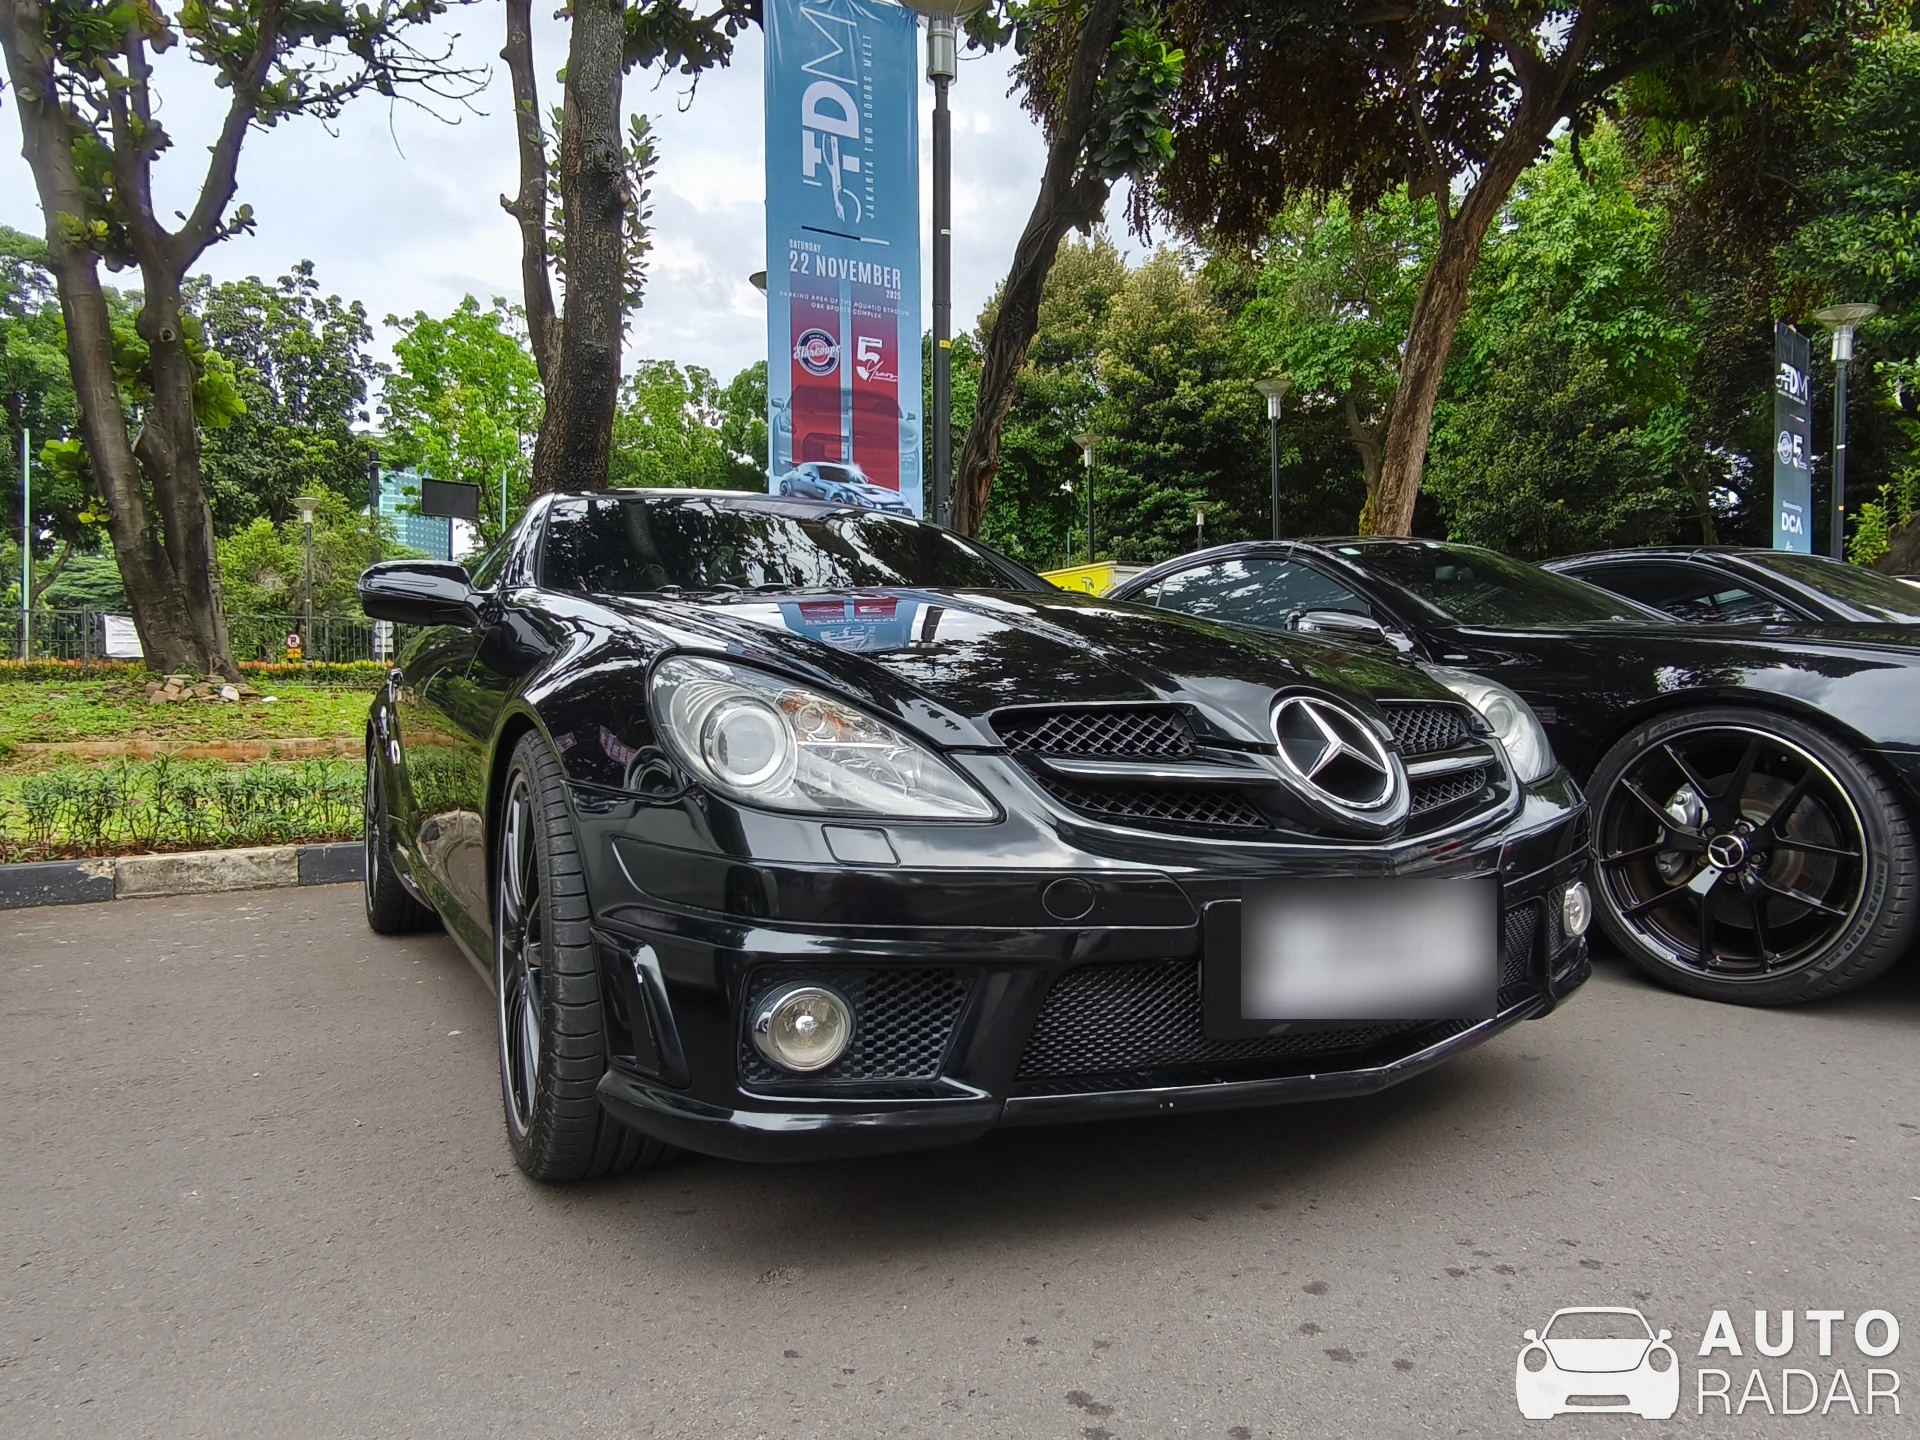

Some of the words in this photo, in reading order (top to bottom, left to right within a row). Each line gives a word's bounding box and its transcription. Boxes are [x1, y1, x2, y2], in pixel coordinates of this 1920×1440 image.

[863, 35, 873, 68] MEET
[863, 76, 874, 119] DOORS
[864, 128, 874, 152] TWO
[864, 161, 875, 219] JAKARTA
[789, 239, 822, 253] SATURDAY
[789, 250, 810, 275] 22
[815, 255, 902, 290] NOVEMBER
[779, 290, 809, 300] PARKING
[811, 294, 828, 303] AREA
[853, 301, 882, 312] AQUATIC
[886, 289, 902, 301] 2025
[852, 309, 882, 319] COMPLEX
[856, 336, 883, 381] 5
